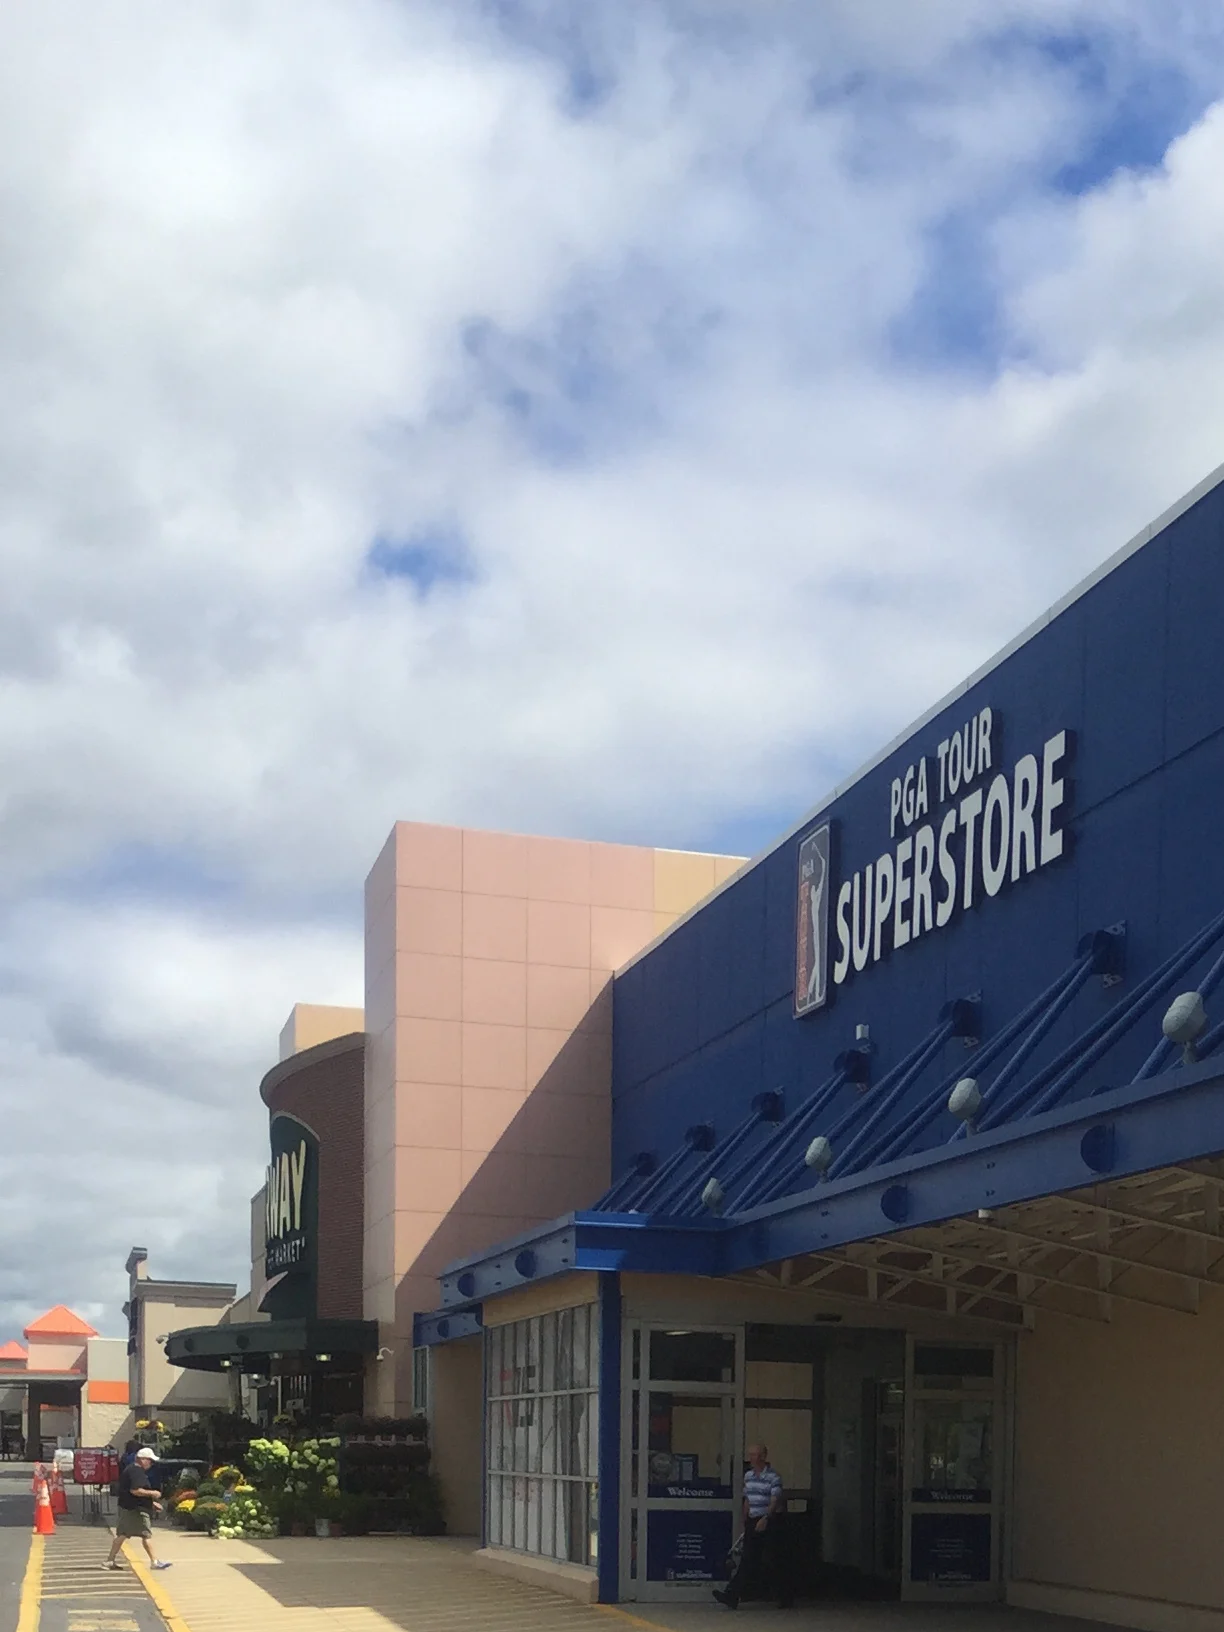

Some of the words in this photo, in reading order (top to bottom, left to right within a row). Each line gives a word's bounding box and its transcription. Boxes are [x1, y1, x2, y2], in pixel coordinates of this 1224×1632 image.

[890, 756, 928, 838] PGA
[937, 706, 992, 803] TOUR
[833, 729, 1066, 985] SUPERSTORE
[667, 1486, 714, 1497] Welcome
